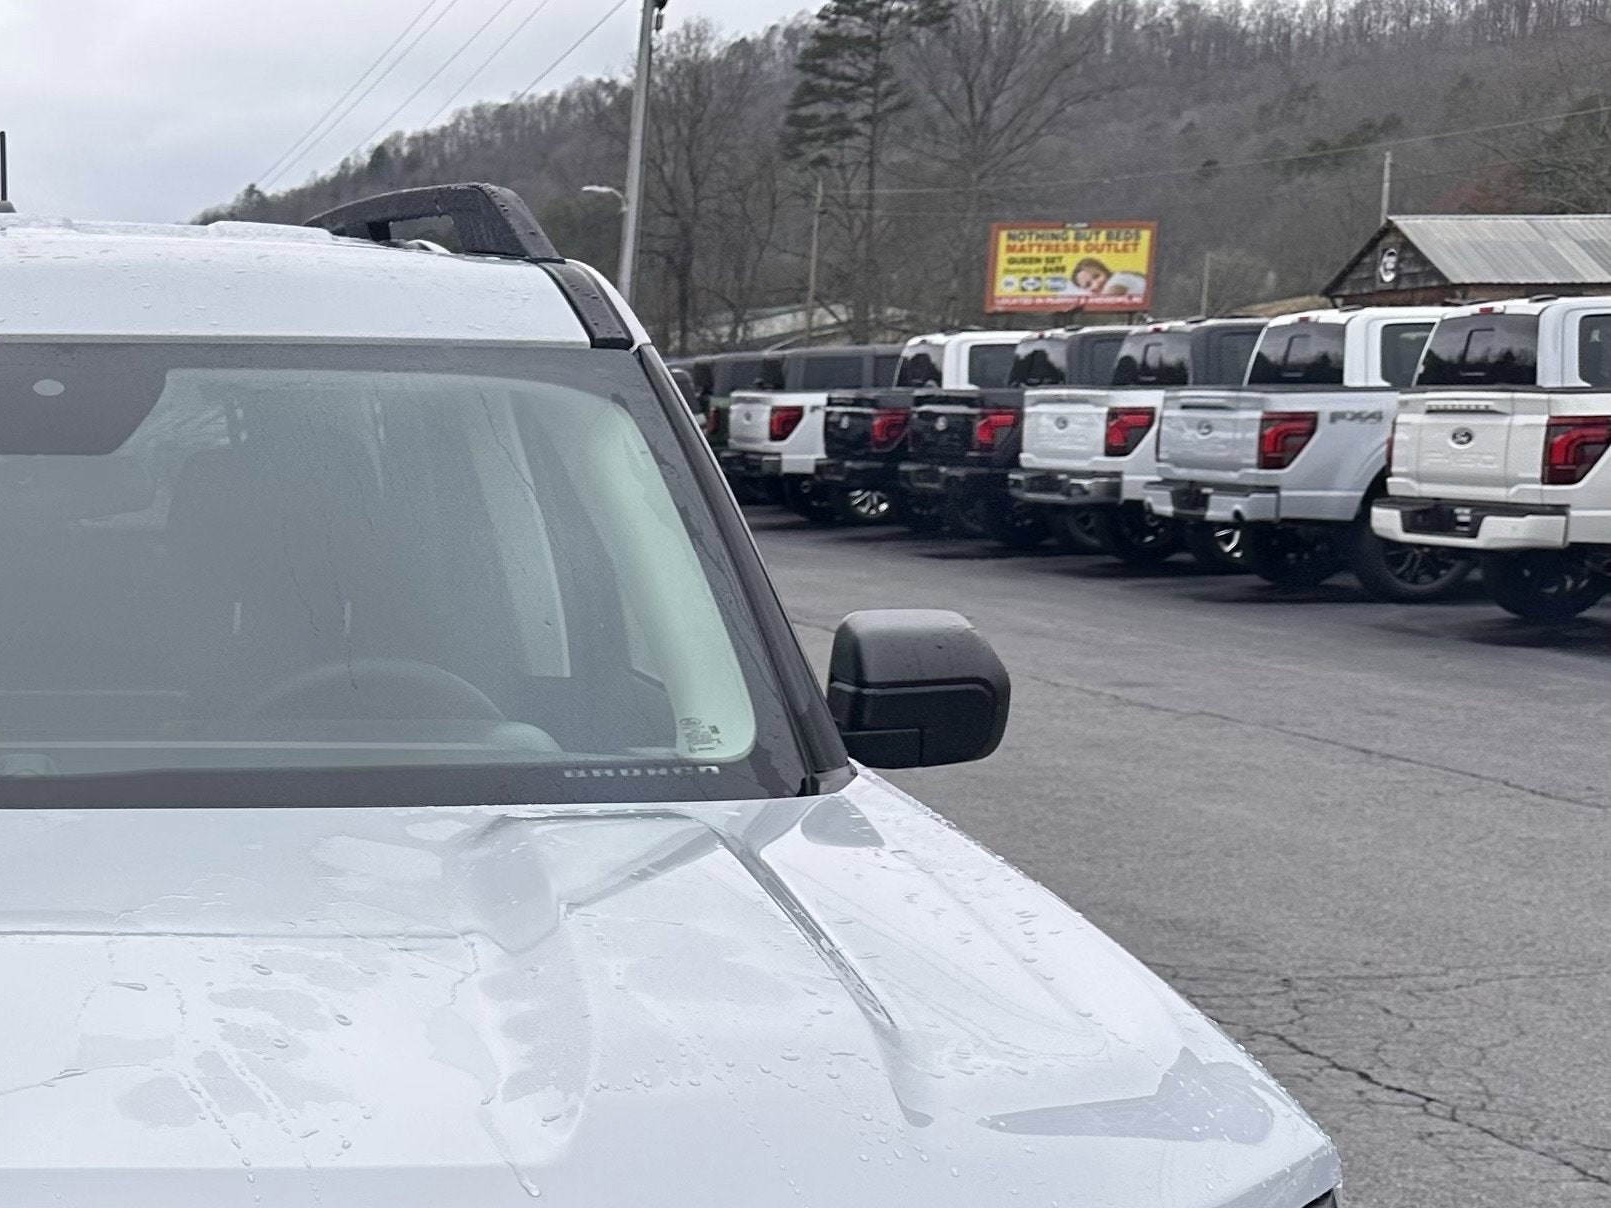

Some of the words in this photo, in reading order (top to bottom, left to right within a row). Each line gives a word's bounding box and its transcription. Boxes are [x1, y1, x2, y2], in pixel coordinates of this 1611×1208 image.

[1007, 230, 1069, 241] NOTHING
[1074, 230, 1102, 241] BUT
[1106, 230, 1141, 241] BEDS
[1006, 243, 1080, 254] MATTRESS
[1085, 242, 1140, 253] OUTLET
